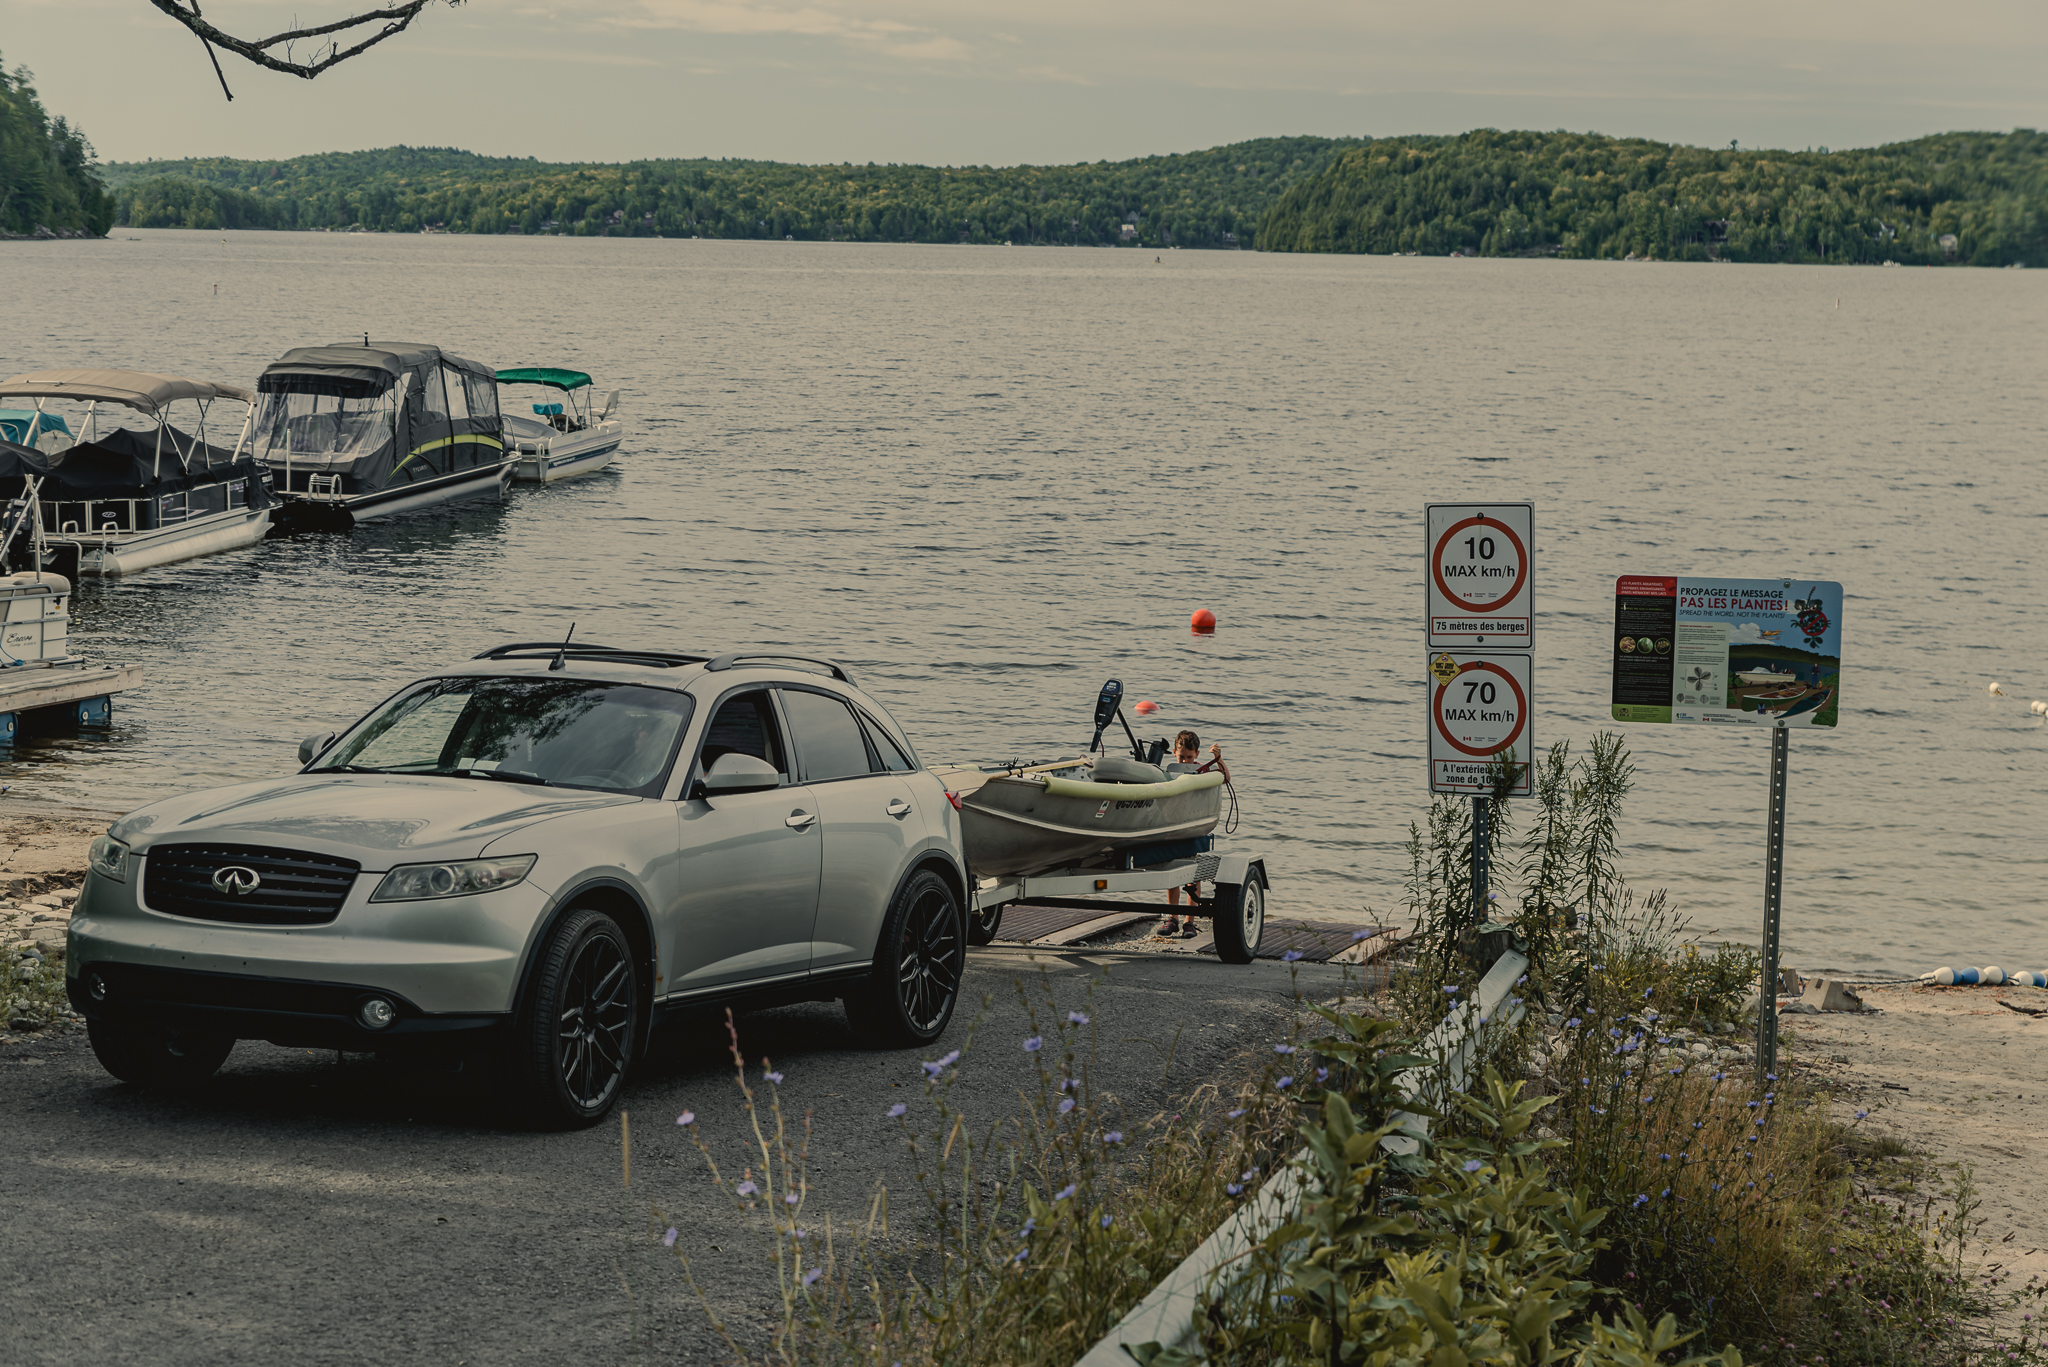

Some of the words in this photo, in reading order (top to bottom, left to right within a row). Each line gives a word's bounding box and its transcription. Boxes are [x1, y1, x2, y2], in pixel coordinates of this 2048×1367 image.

[1464, 537, 1495, 560] 10
[1445, 565, 1477, 577] MAX
[1481, 565, 1515, 578] km/h
[1680, 587, 1728, 597] PROPAGEZ
[1730, 589, 1739, 597] LE
[1741, 590, 1784, 599] MESSAGE
[1680, 597, 1704, 608] PAS
[1708, 598, 1727, 609] LES
[1436, 621, 1447, 630] 75
[1450, 621, 1478, 630] mètres
[1480, 622, 1495, 630] des
[1497, 622, 1525, 632] berges
[1463, 682, 1496, 704] 70
[1445, 709, 1477, 721] MAX
[1481, 710, 1515, 723] km/h
[1443, 761, 1448, 773] À
[1446, 775, 1465, 783] zone
[1467, 775, 1478, 783] de
[1480, 775, 1492, 784] 10
